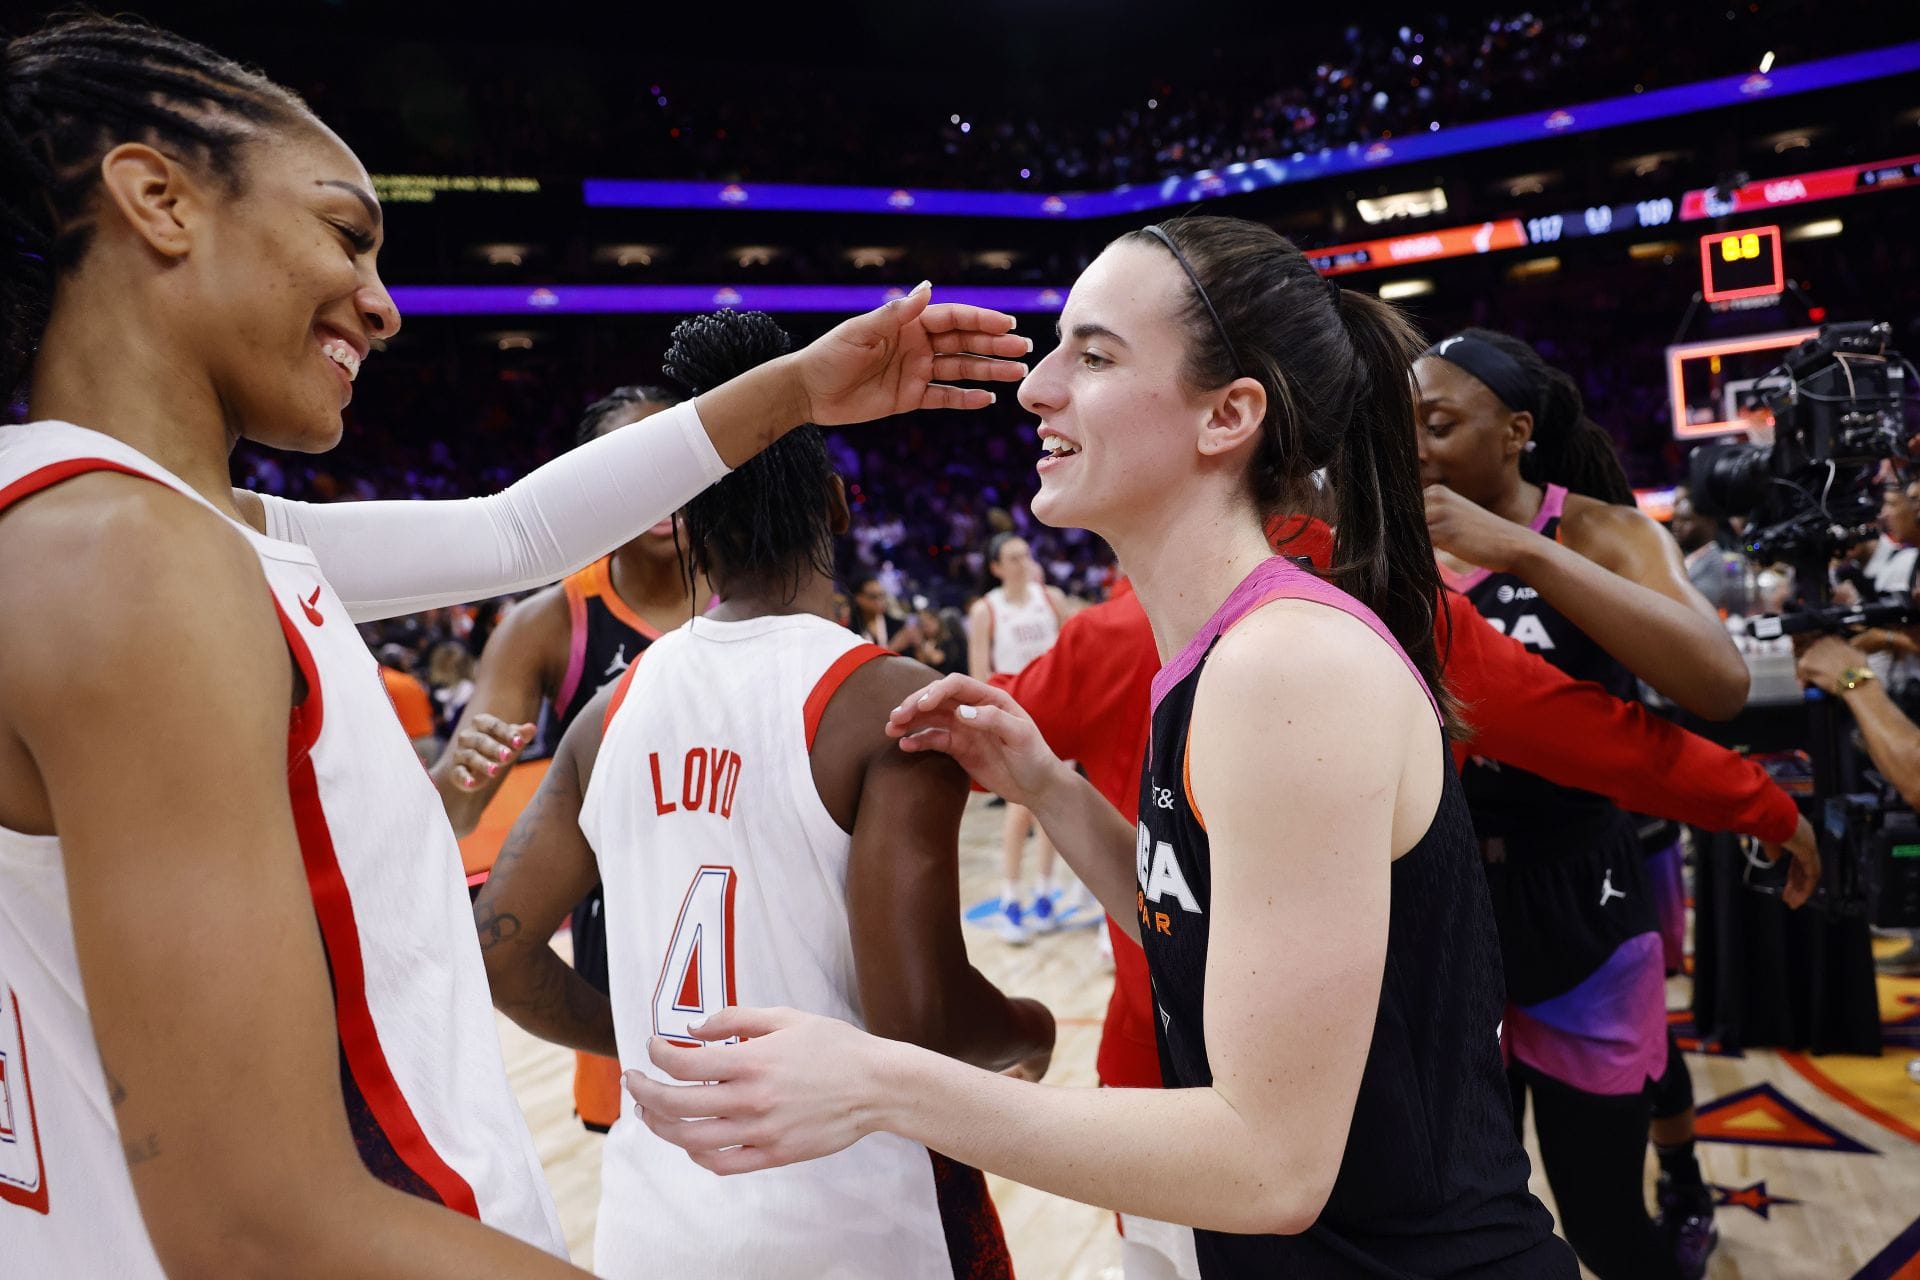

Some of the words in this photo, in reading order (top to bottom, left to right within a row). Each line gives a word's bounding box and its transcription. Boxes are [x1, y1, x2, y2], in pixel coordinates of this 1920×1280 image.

[1528, 214, 1563, 243] 117
[1637, 198, 1673, 227] 109
[1764, 179, 1807, 202] USA
[649, 747, 742, 820] LOYD
[652, 865, 738, 1048] 4
